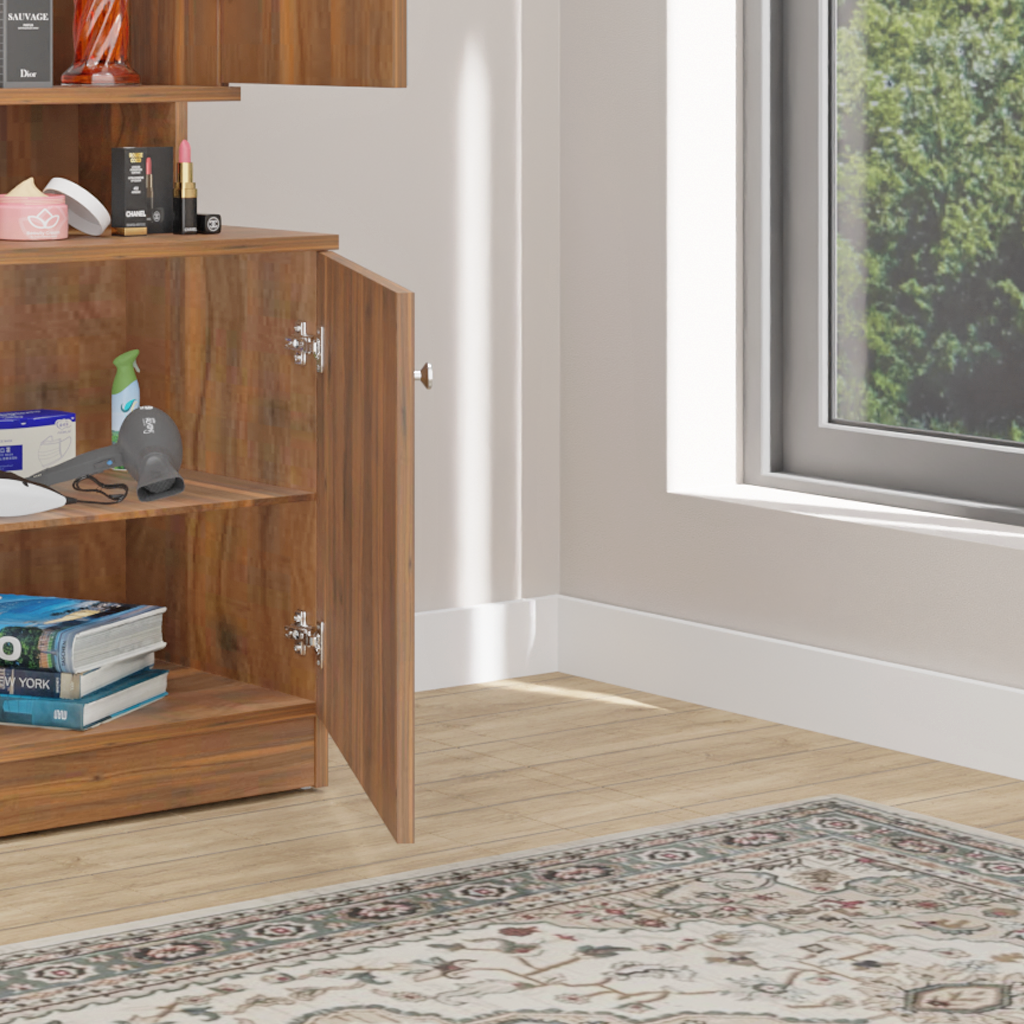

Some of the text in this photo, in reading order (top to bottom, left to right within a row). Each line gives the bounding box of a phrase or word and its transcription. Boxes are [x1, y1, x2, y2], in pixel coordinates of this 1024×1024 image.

[7, 12, 49, 21] SAUVAGE
[20, 68, 37, 78] Dior
[125, 210, 147, 218] CHANEL
[18, 677, 51, 690] YORK
